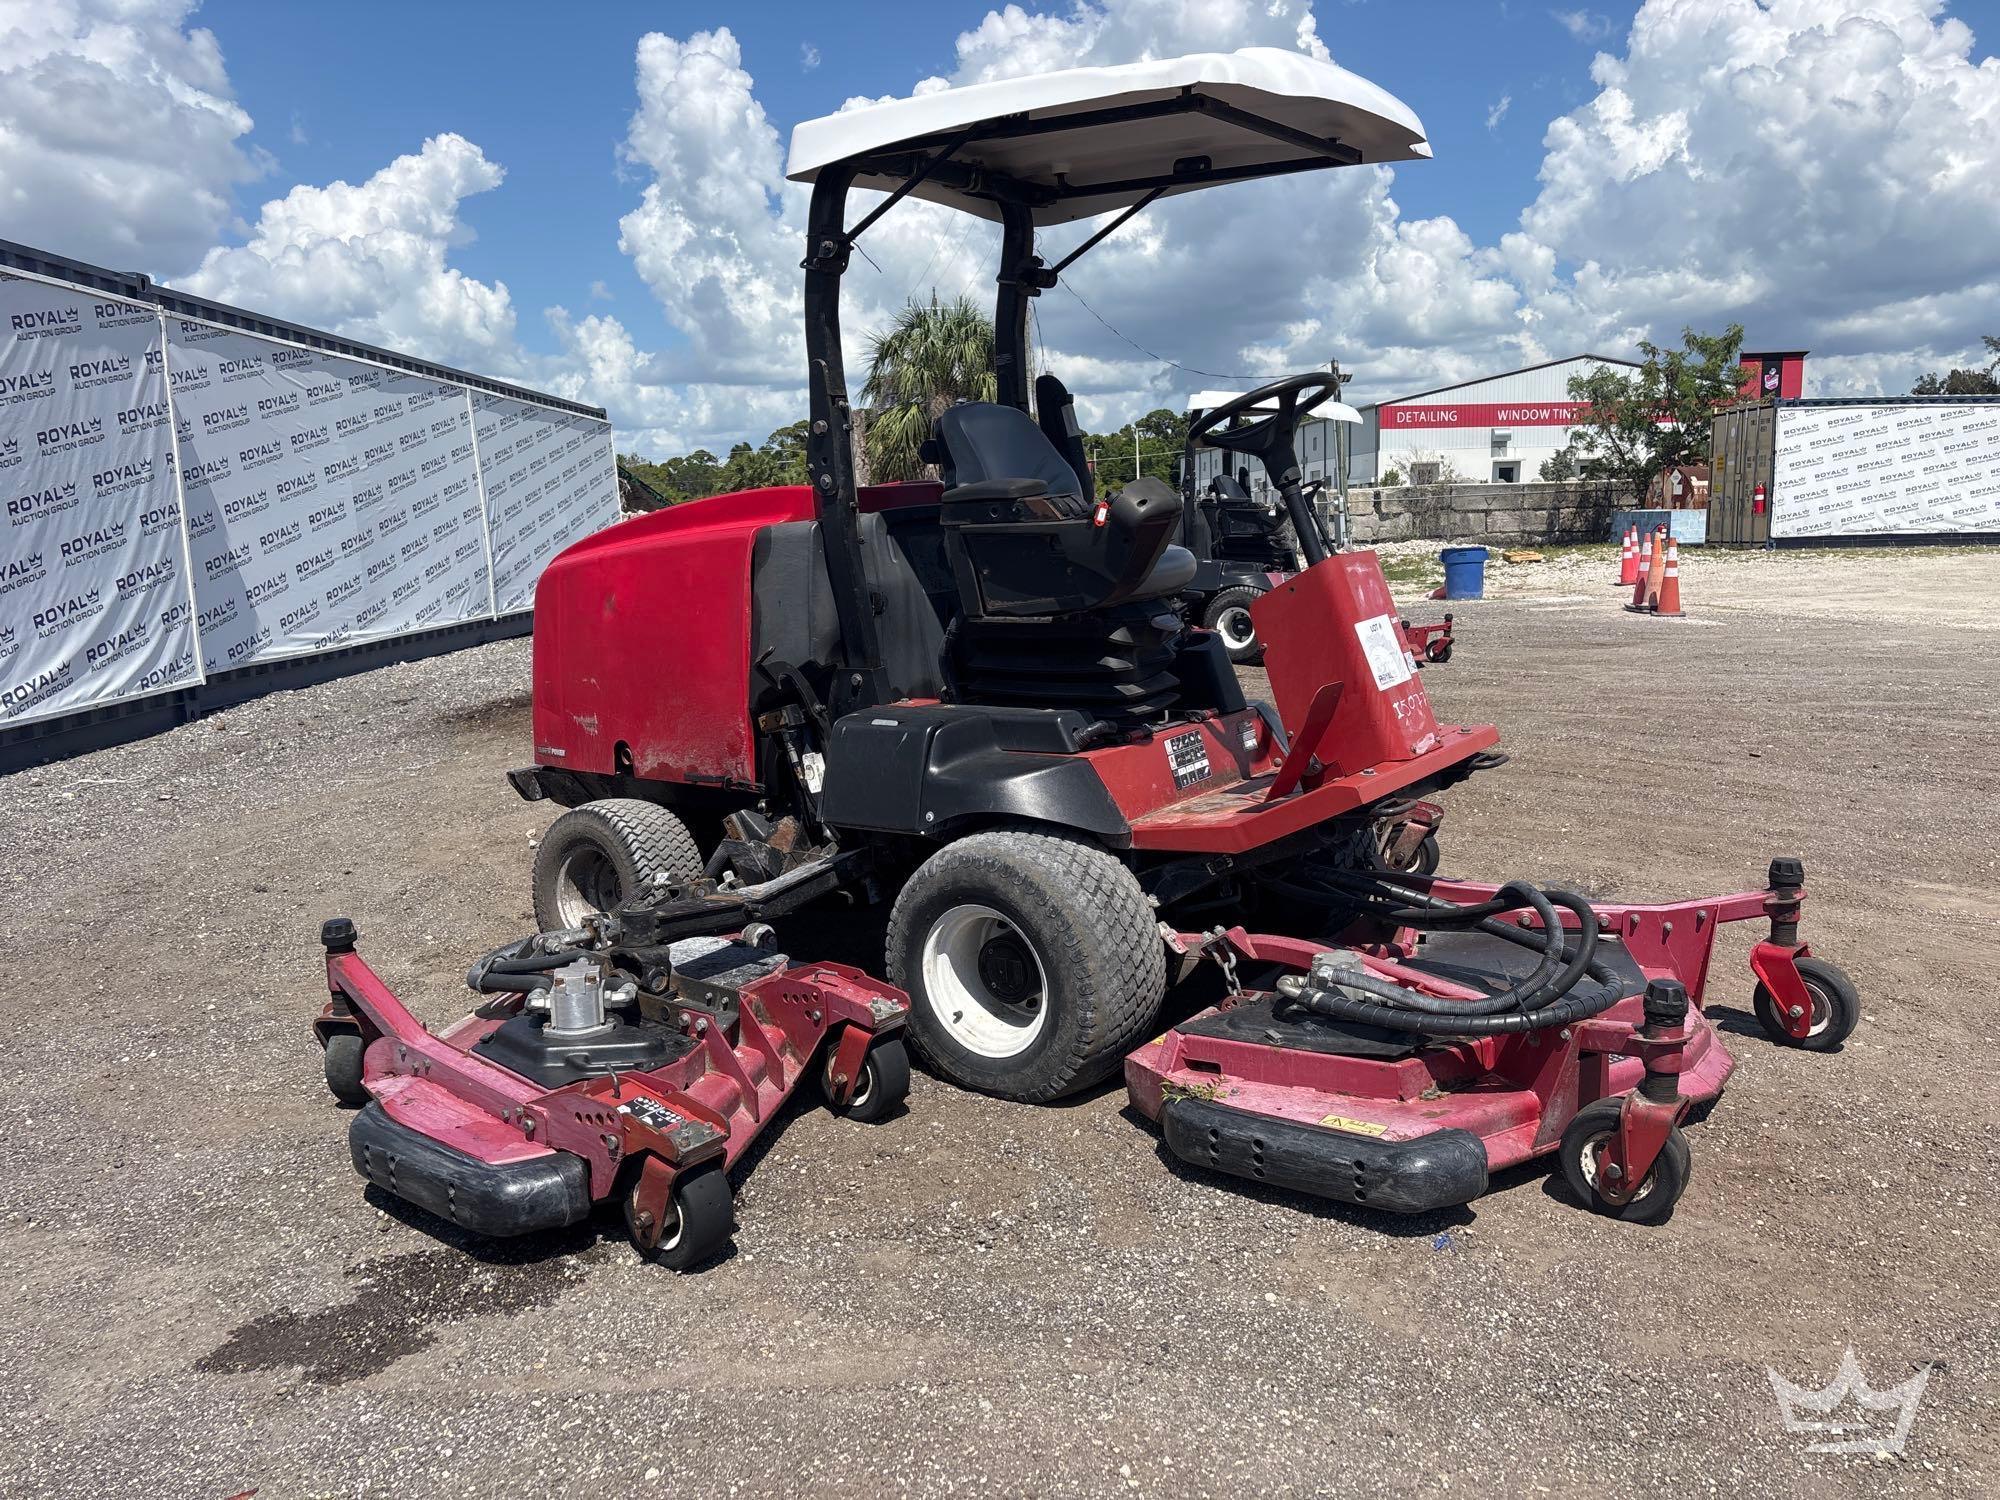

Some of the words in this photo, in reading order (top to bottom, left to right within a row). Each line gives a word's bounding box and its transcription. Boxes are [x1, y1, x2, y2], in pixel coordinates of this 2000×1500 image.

[11, 310, 68, 330] ROYAL
[99, 318, 129, 329] AUCTION
[130, 315, 154, 326] GROUP
[18, 330, 54, 341] AUCTION
[55, 326, 81, 335] GROUP
[272, 349, 304, 363] ROYAL
[70, 359, 121, 379] ROYAL
[219, 358, 255, 374] ROYAL
[276, 363, 296, 372] AUCTION
[75, 378, 107, 390] AUCTION
[109, 373, 132, 383] GROUP
[224, 373, 246, 383] AUCTION
[247, 370, 264, 378] GROUP
[348, 373, 374, 387] ROYAL
[26, 388, 56, 401] GROUP
[191, 381, 211, 391] GROUP
[306, 383, 336, 398] ROYAL
[258, 395, 291, 411] ROYAL
[408, 392, 429, 406] ROYAL
[118, 402, 163, 425] ROYAL
[203, 408, 240, 426] ROYAL
[262, 409, 283, 420] AUCTION
[283, 405, 299, 413] GROUP
[374, 403, 398, 418] ROYAL
[1397, 410, 1457, 422] DETAILING
[1498, 409, 1550, 420] WINDOW
[1940, 409, 1968, 418] ROYAL
[121, 421, 152, 436] AUCTION
[153, 415, 171, 427] GROU
[208, 424, 231, 435] AUCTION
[232, 418, 249, 428] GROUP
[336, 415, 362, 431] ROYAL
[431, 419, 451, 433] ROYAL
[1827, 416, 1856, 425] ROYAL
[1897, 418, 1925, 427] ROYAL
[1962, 421, 1990, 430] ROYAL
[36, 422, 91, 446] ROYAL
[291, 429, 322, 446] ROYAL
[399, 431, 422, 446] ROYAL
[1784, 426, 1812, 435] ROYAL
[1853, 428, 1881, 437] ROYAL
[1919, 430, 1947, 439] ROYAL
[42, 442, 77, 457] AUCTION
[78, 434, 104, 447] GROUP
[1810, 437, 1838, 446] ROYAL
[1944, 442, 1972, 451] ROYAL
[239, 444, 274, 463] ROYAL
[364, 444, 389, 460] ROYAL
[451, 444, 470, 458] ROYAL
[1832, 449, 1860, 458] ROYAL
[1901, 451, 1928, 460] ROYAL
[1966, 454, 1993, 463] ROYAL
[244, 459, 266, 471] AUCTION
[266, 453, 283, 463] GROUP
[325, 460, 351, 476] ROYAL
[421, 457, 442, 472] ROYAL
[1789, 458, 1817, 467] ROYAL
[1857, 460, 1885, 469] ROYAL
[1923, 463, 1950, 472] ROYAL
[92, 464, 143, 488] ROYAL
[183, 461, 221, 482] ROYAL
[388, 472, 411, 488] ROYAL
[1815, 470, 1842, 479] ROYAL
[1880, 472, 1908, 481] ROYAL
[1948, 474, 1975, 483] ROYAL
[98, 483, 130, 499] AUCTION
[131, 475, 154, 487] GROUP
[188, 478, 212, 491] AUCTION
[213, 471, 231, 482] GROUP
[277, 475, 309, 495] ROYAL
[444, 481, 463, 496] ROYAL
[1836, 482, 1864, 490] ROYAL
[1905, 483, 1933, 492] ROYAL
[7, 488, 65, 516] ROYAL
[353, 488, 377, 505] ROYAL
[1794, 491, 1821, 500] ROYAL
[1861, 493, 1889, 502] ROYAL
[13, 509, 50, 527] AUCTION
[51, 499, 78, 514] GROUP
[224, 494, 260, 515] ROYAL
[412, 496, 434, 513] ROYAL
[1818, 502, 1846, 511] ROYAL
[1883, 504, 1912, 513] ROYAL
[229, 510, 251, 524] AUCTION
[252, 503, 269, 514] GROUP
[308, 506, 339, 525] ROYAL
[379, 513, 402, 531] ROYAL
[143, 521, 173, 537] AUCTION
[259, 526, 293, 547] ROYAL
[433, 520, 454, 537] ROYAL
[60, 529, 114, 557] ROYAL
[264, 541, 285, 556] AUCTION
[286, 534, 302, 545] GROUP
[341, 533, 367, 552] ROYAL
[401, 539, 424, 557] ROYAL
[455, 541, 475, 558] ROYAL
[67, 549, 100, 568] AUCTION
[101, 539, 126, 553] GROUP
[205, 549, 243, 573] ROYAL
[210, 566, 234, 582] AUCTION
[234, 557, 252, 569] GROUP
[296, 553, 327, 575] ROYAL
[367, 558, 391, 577] ROYAL
[425, 560, 446, 578] ROYAL
[16, 569, 47, 588] GROUP
[116, 564, 164, 592] ROYAL
[121, 583, 152, 602] AUCTION
[153, 572, 175, 587] GROUP
[246, 577, 280, 601] ROYAL
[326, 580, 355, 601] ROYAL
[393, 580, 415, 600] ROYAL
[446, 581, 465, 600] ROYAL
[250, 594, 272, 609] AUCTION
[272, 584, 289, 597] GROUP
[33, 596, 89, 629] ROYAL
[219, 612, 239, 625] GROUP
[280, 605, 312, 629] ROYAL
[357, 603, 382, 624] ROYAL
[416, 602, 437, 622] ROYAL
[40, 618, 75, 640] AUCTION
[76, 605, 103, 622] GROUP
[86, 631, 137, 663] ROYAL
[227, 633, 264, 660] ROYAL
[92, 651, 124, 673] AUCTION
[125, 638, 149, 655] GROUP
[140, 658, 183, 690] ROYAL
[2, 670, 60, 708] ROYAL
[9, 694, 46, 719] AUCTION
[47, 677, 74, 697] GROUP
